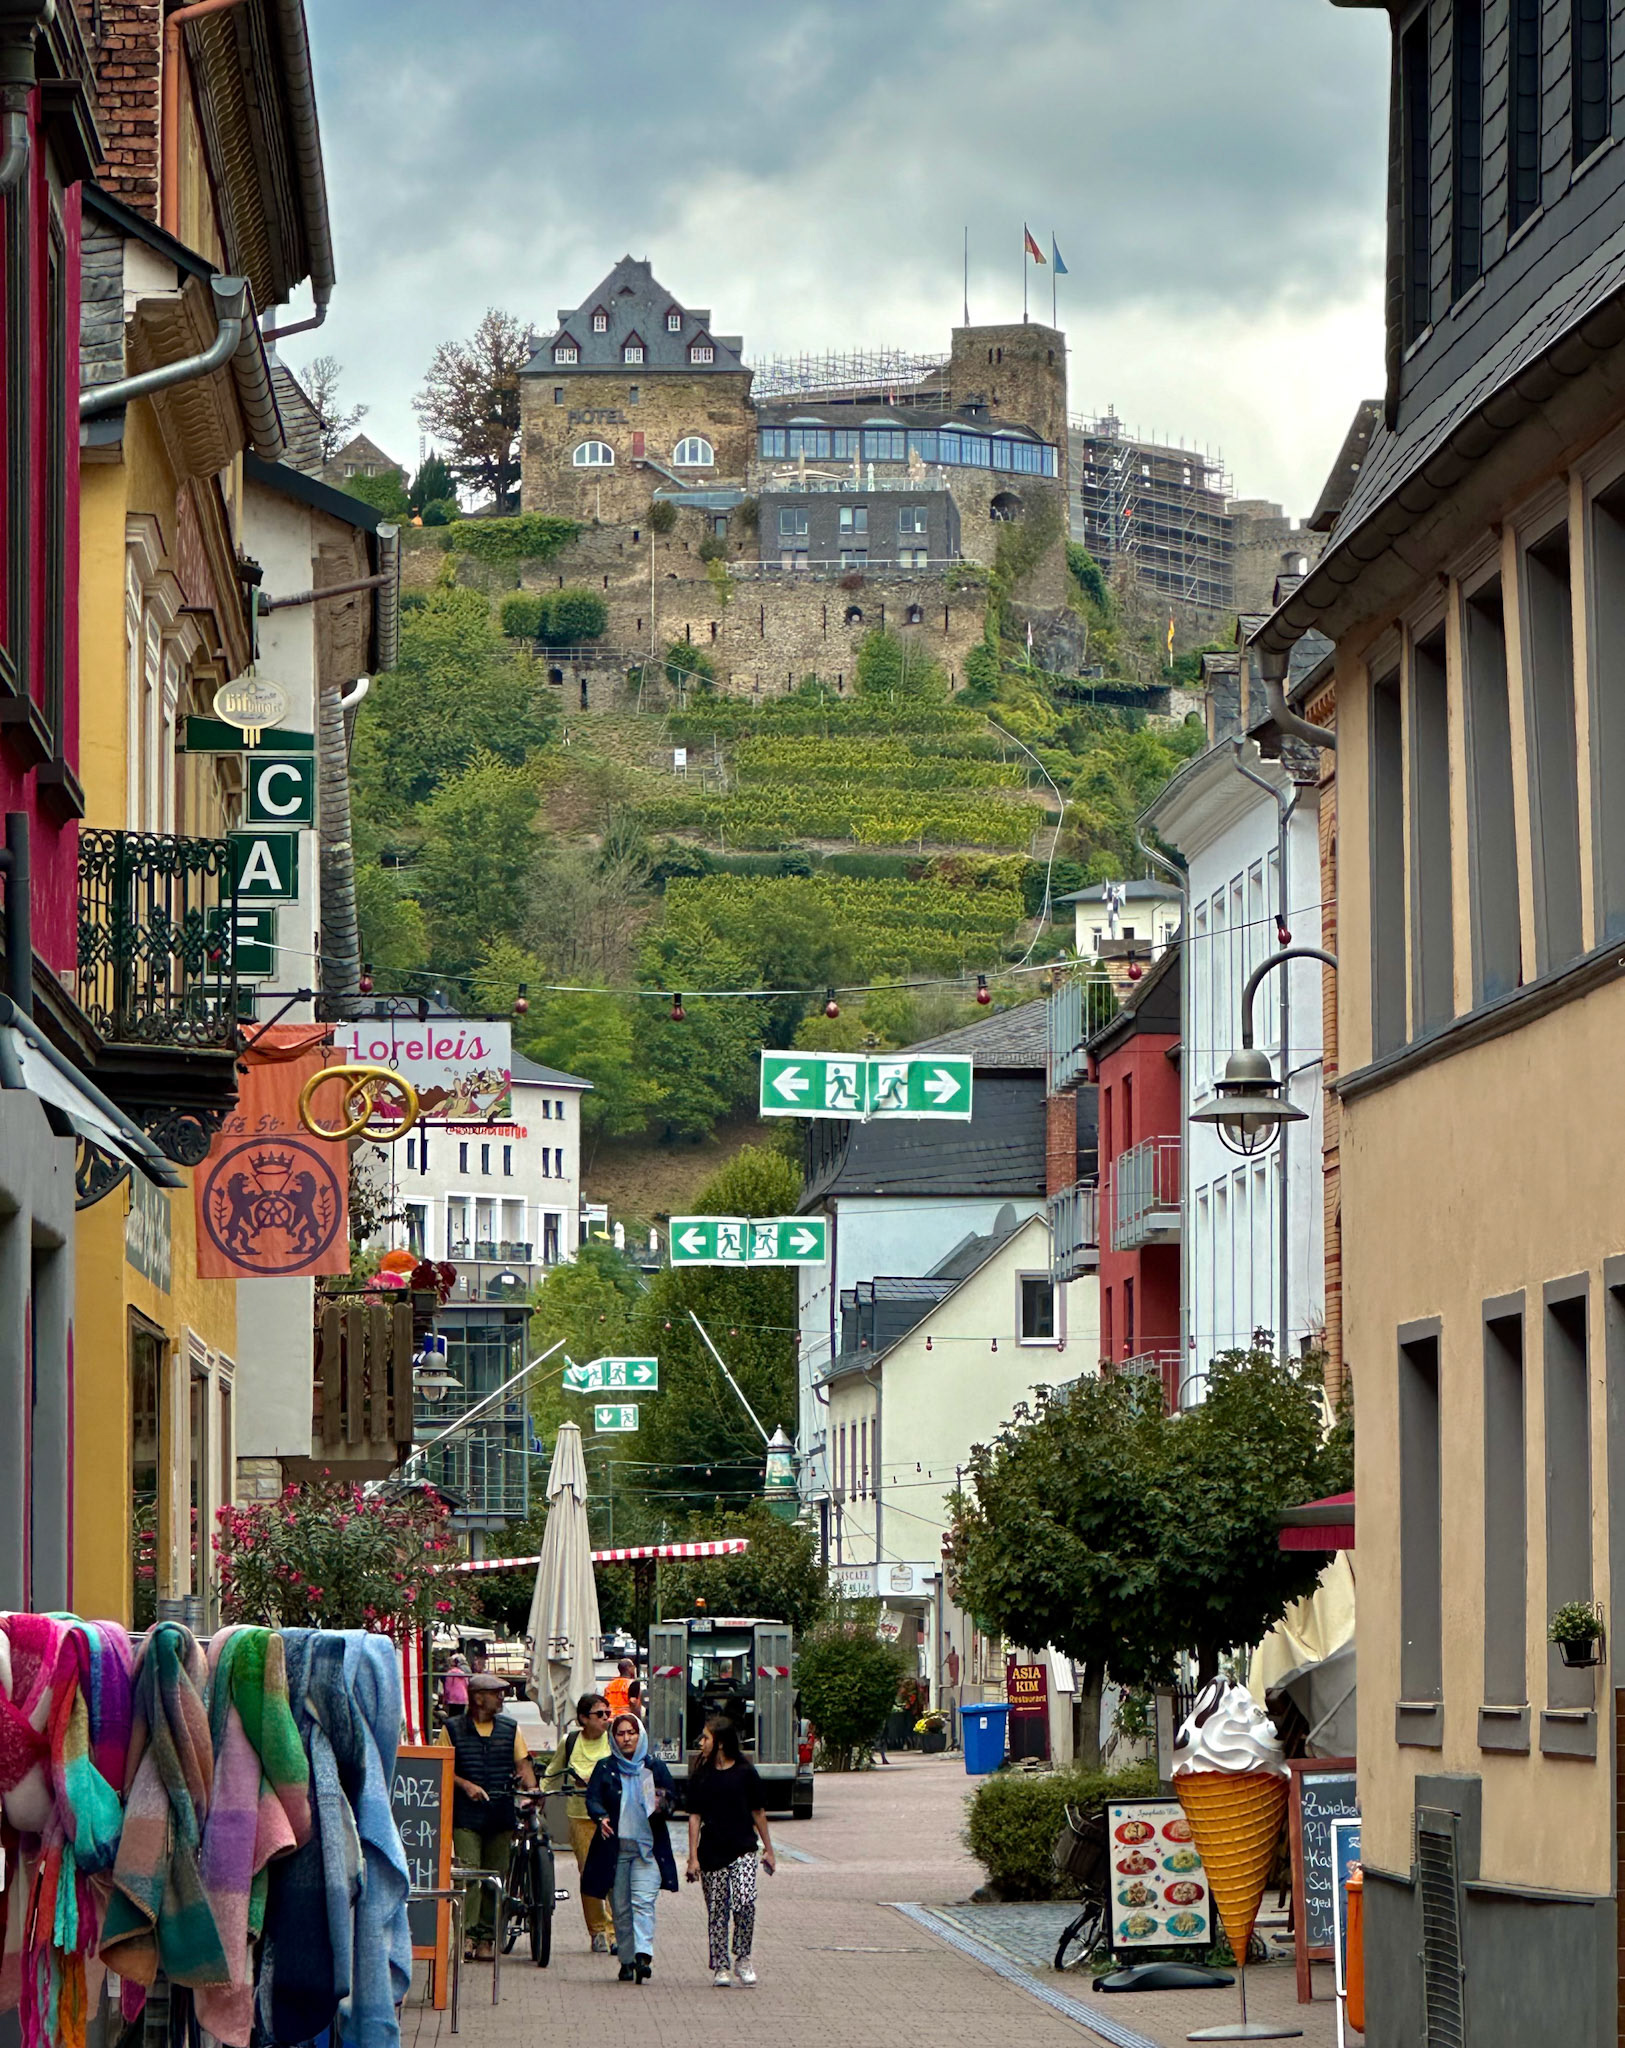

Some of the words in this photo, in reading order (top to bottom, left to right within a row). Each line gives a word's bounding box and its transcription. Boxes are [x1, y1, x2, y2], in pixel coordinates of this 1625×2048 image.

[568, 408, 629, 424] HOTEL
[353, 1027, 491, 1060] Loreleis
[1012, 1666, 1041, 1680] ASIA
[1016, 1680, 1039, 1692] KIM
